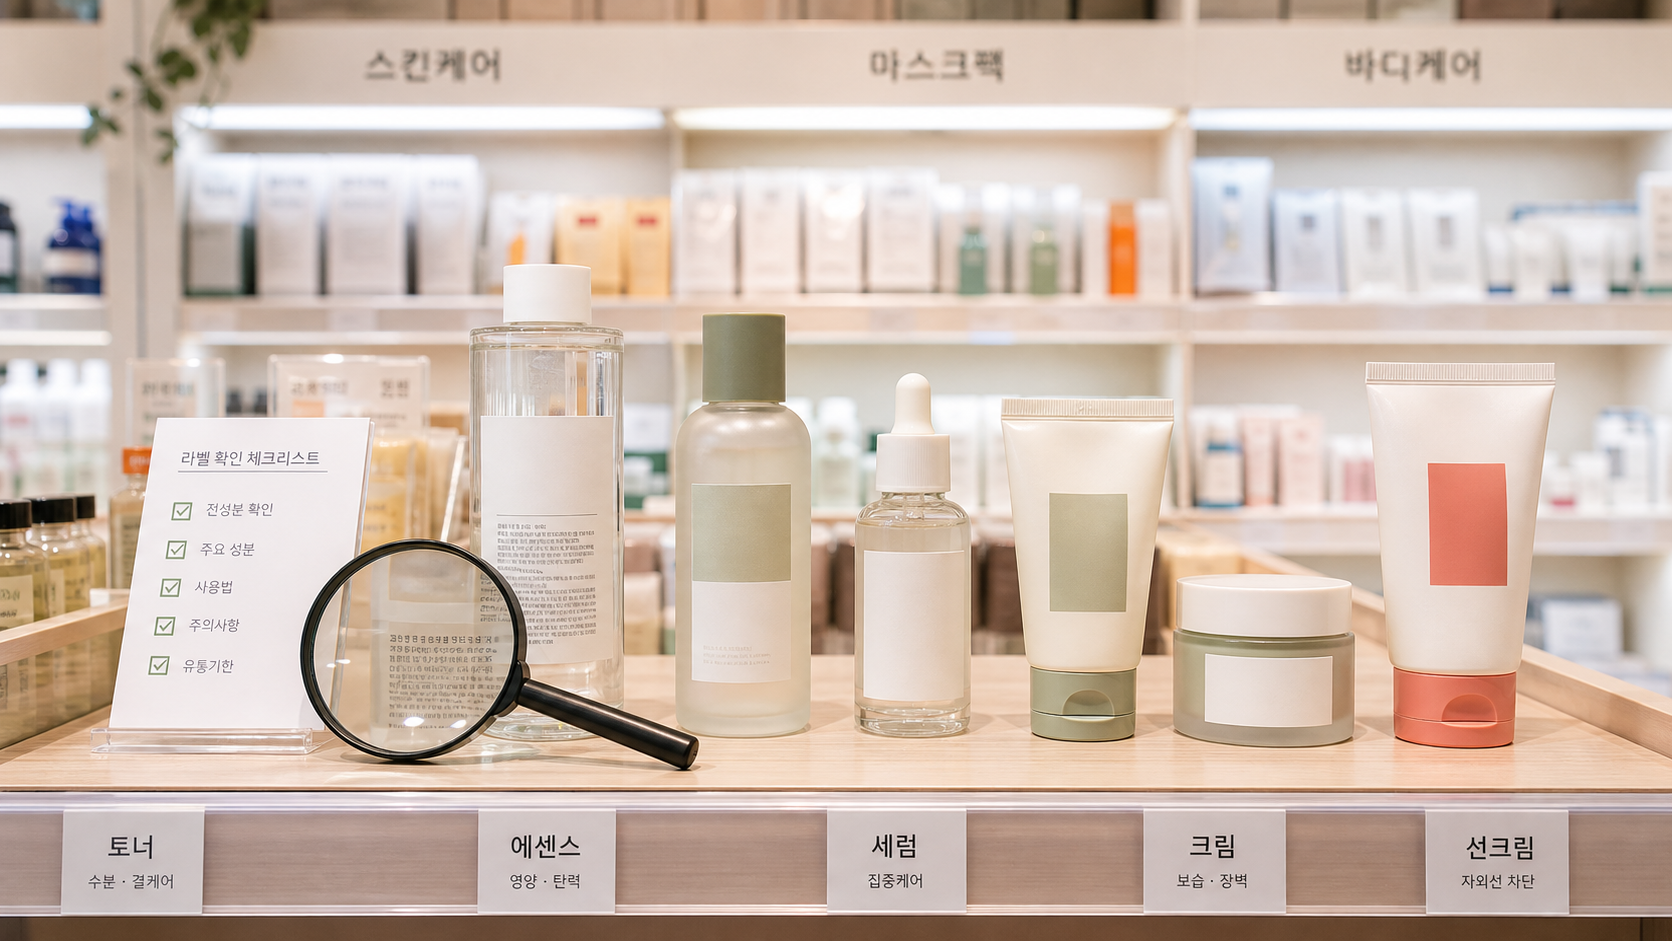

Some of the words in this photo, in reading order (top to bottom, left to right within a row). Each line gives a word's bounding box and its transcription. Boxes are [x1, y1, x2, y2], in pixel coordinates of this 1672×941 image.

[366, 48, 501, 83] 스킨케어
[1344, 48, 1482, 83] 바디케어
[181, 451, 211, 467] 라벨
[214, 450, 243, 467] 확인
[246, 450, 320, 467] 체크리스트
[206, 502, 244, 517] 전성분
[248, 502, 274, 517] 확인
[200, 542, 225, 557] 주요
[229, 542, 255, 557] 성분
[194, 580, 233, 595] 사용법
[188, 618, 240, 633] 주의사항
[182, 659, 234, 674] 유통기한
[107, 834, 153, 860] 토너
[511, 834, 581, 860] 에센스
[871, 833, 916, 859] 세럼
[1189, 834, 1235, 859] 크림
[1466, 835, 1533, 861] 선크림
[88, 874, 116, 890] 수분
[132, 874, 174, 890] 결케어
[509, 873, 538, 890] 영양
[553, 873, 580, 889] 탄력
[868, 873, 923, 889] 집중케어
[1176, 873, 1205, 889] 보습
[1220, 873, 1247, 889] 장벽
[1461, 873, 1502, 890] 자외선
[1507, 874, 1536, 890] 차단
